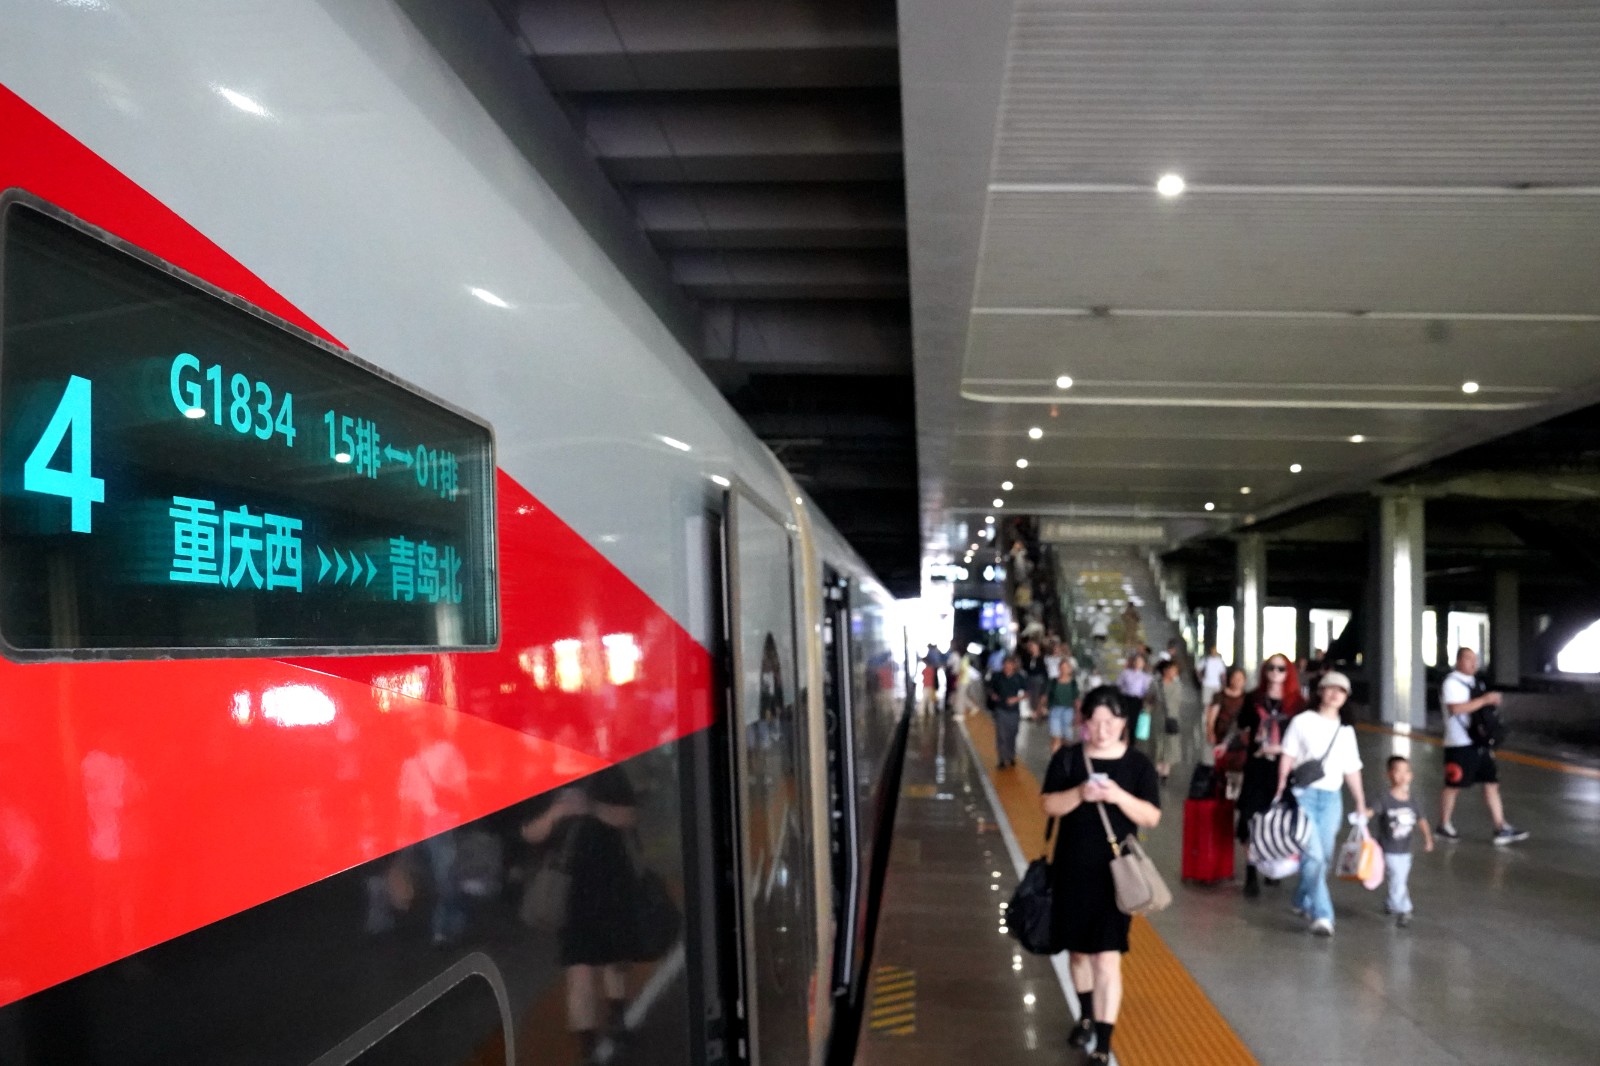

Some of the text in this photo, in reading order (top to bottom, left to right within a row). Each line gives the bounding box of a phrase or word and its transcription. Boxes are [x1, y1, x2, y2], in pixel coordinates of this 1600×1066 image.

[24, 374, 105, 534] 4
[169, 353, 297, 447] G1834
[169, 496, 462, 604] 重庆西 青岛北
